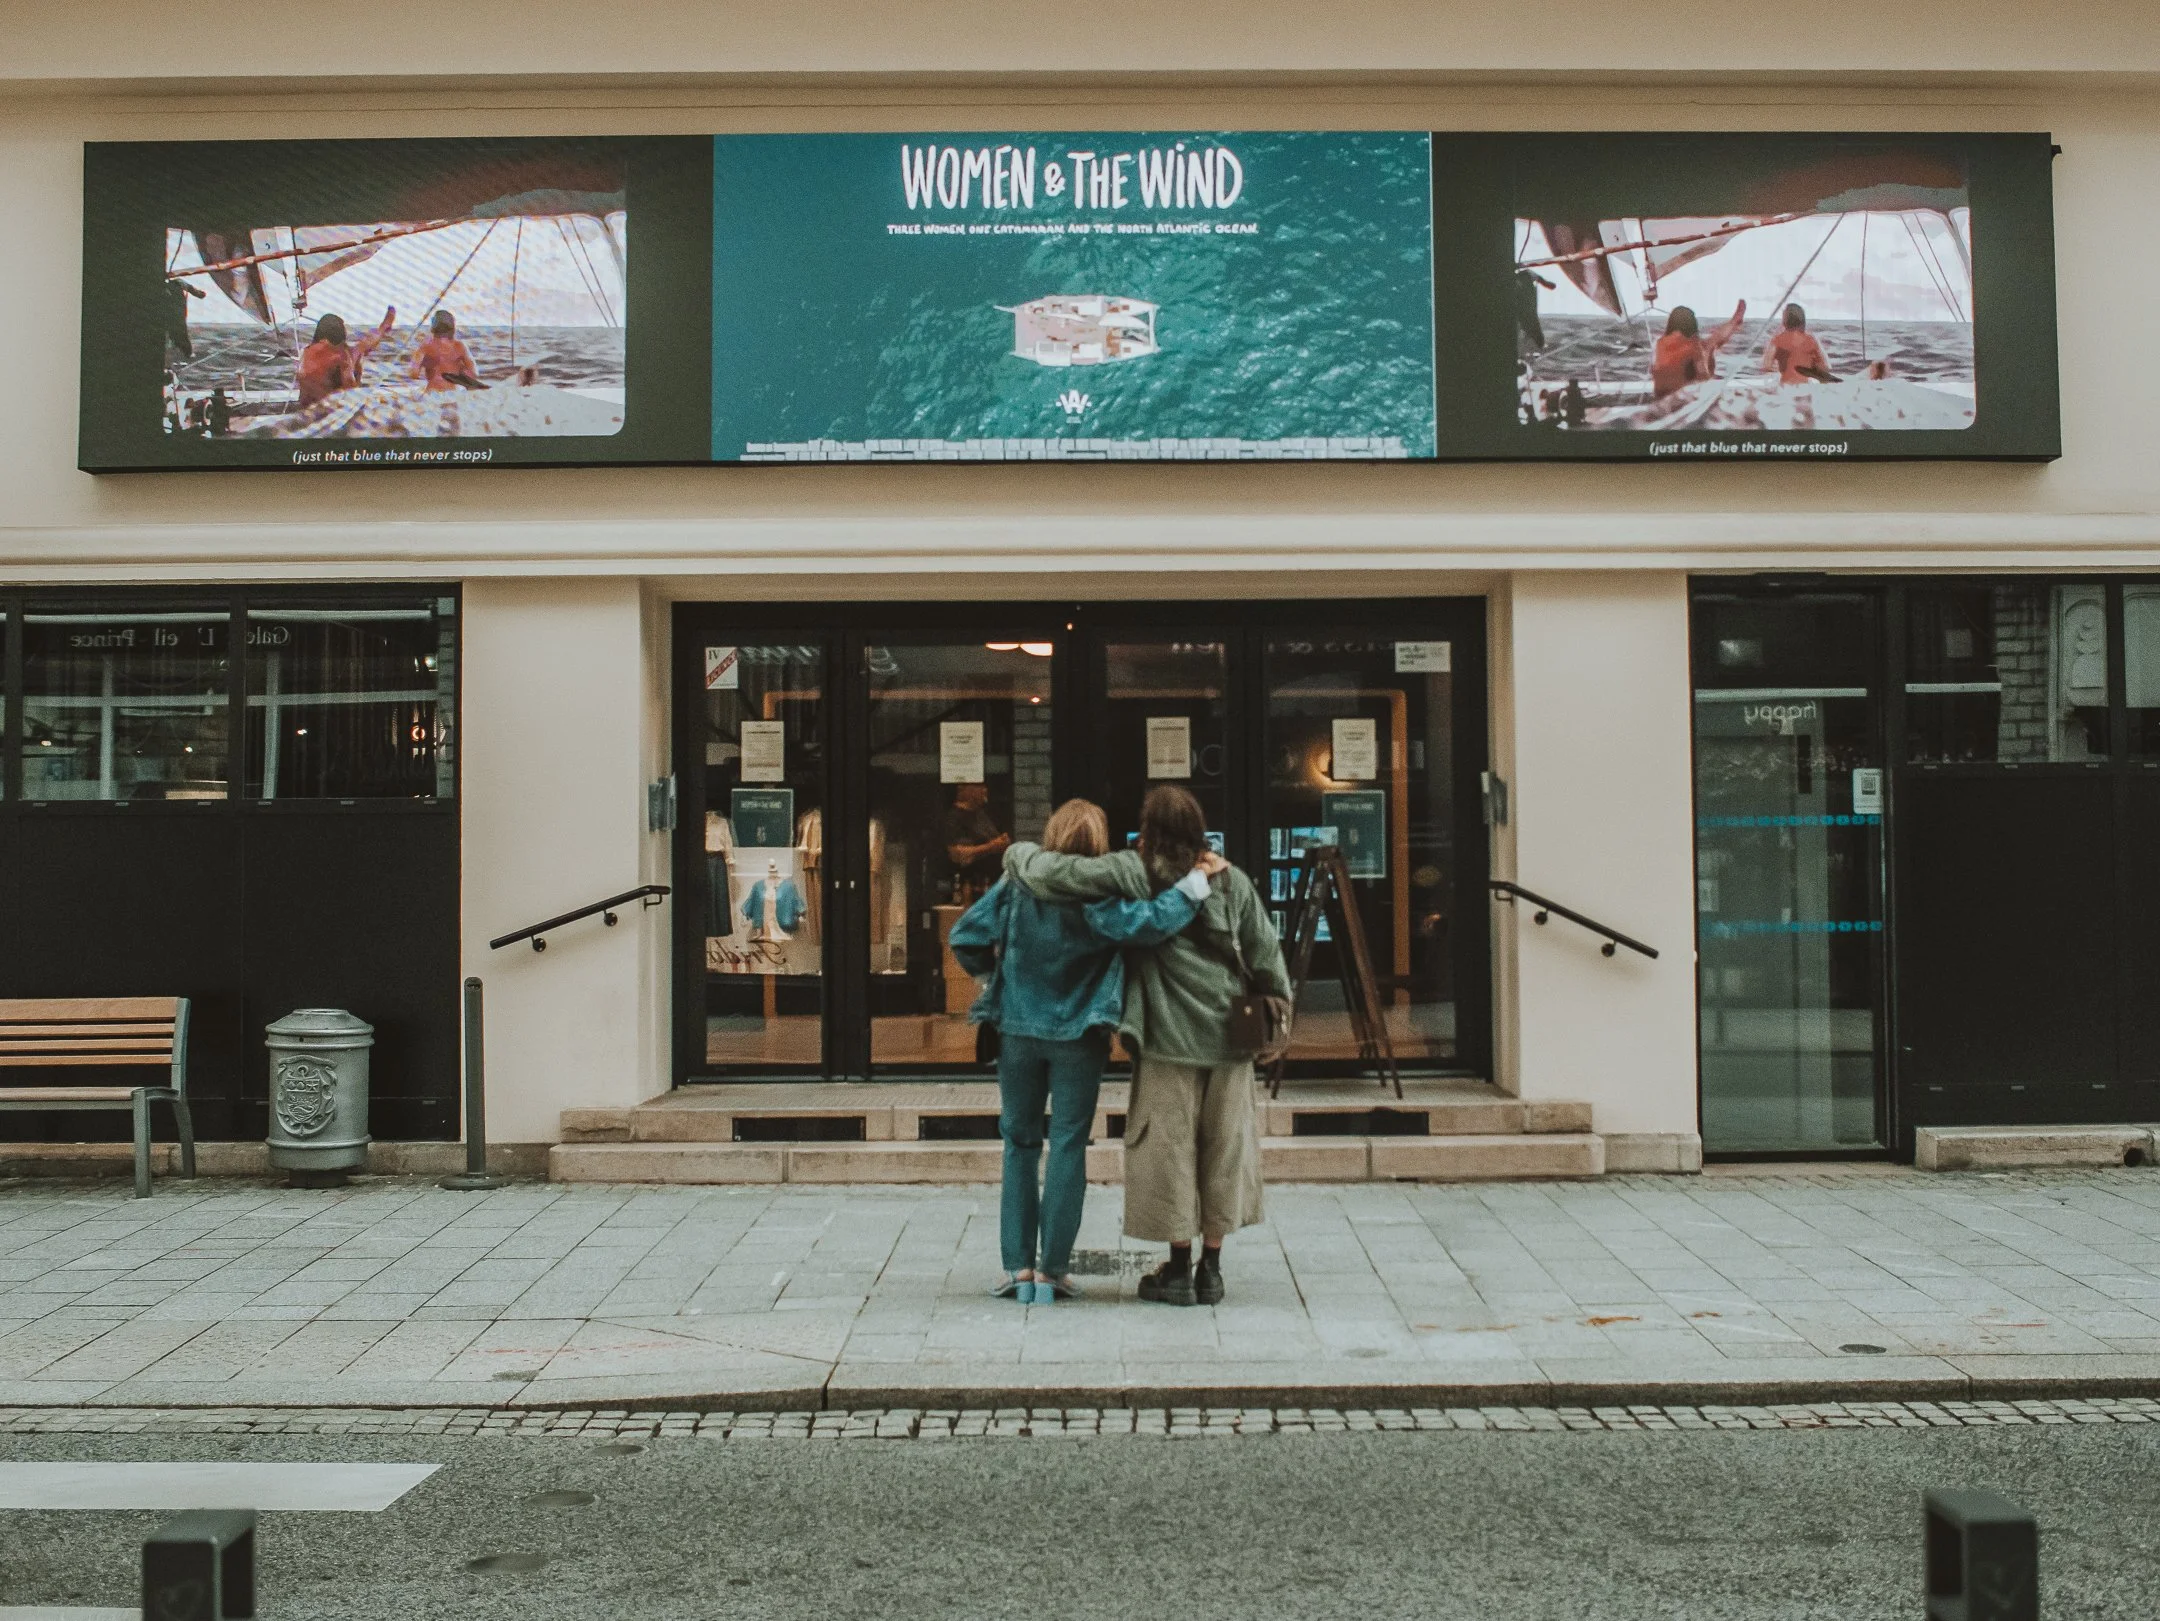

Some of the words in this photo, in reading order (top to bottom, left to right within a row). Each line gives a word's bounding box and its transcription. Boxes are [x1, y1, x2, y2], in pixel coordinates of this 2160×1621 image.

[901, 144, 1036, 210] WOMEN
[1043, 162, 1066, 197] &
[1067, 152, 1134, 210] THE
[887, 224, 921, 235] THREE
[968, 224, 992, 235] ONE
[1067, 223, 1090, 235] AND
[1093, 223, 1114, 235] THE
[1117, 223, 1153, 235] NORTH
[1649, 442, 1678, 456] (just
[1681, 442, 1706, 453] that
[1709, 441, 1739, 453] blue
[1741, 441, 1766, 453] that
[1769, 443, 1806, 453] never
[1808, 442, 1848, 455] stops)
[292, 451, 321, 464] (just
[324, 450, 349, 462] that
[353, 450, 382, 461] blue
[385, 449, 410, 461] that
[413, 451, 450, 461] never
[452, 449, 493, 462] stops)
